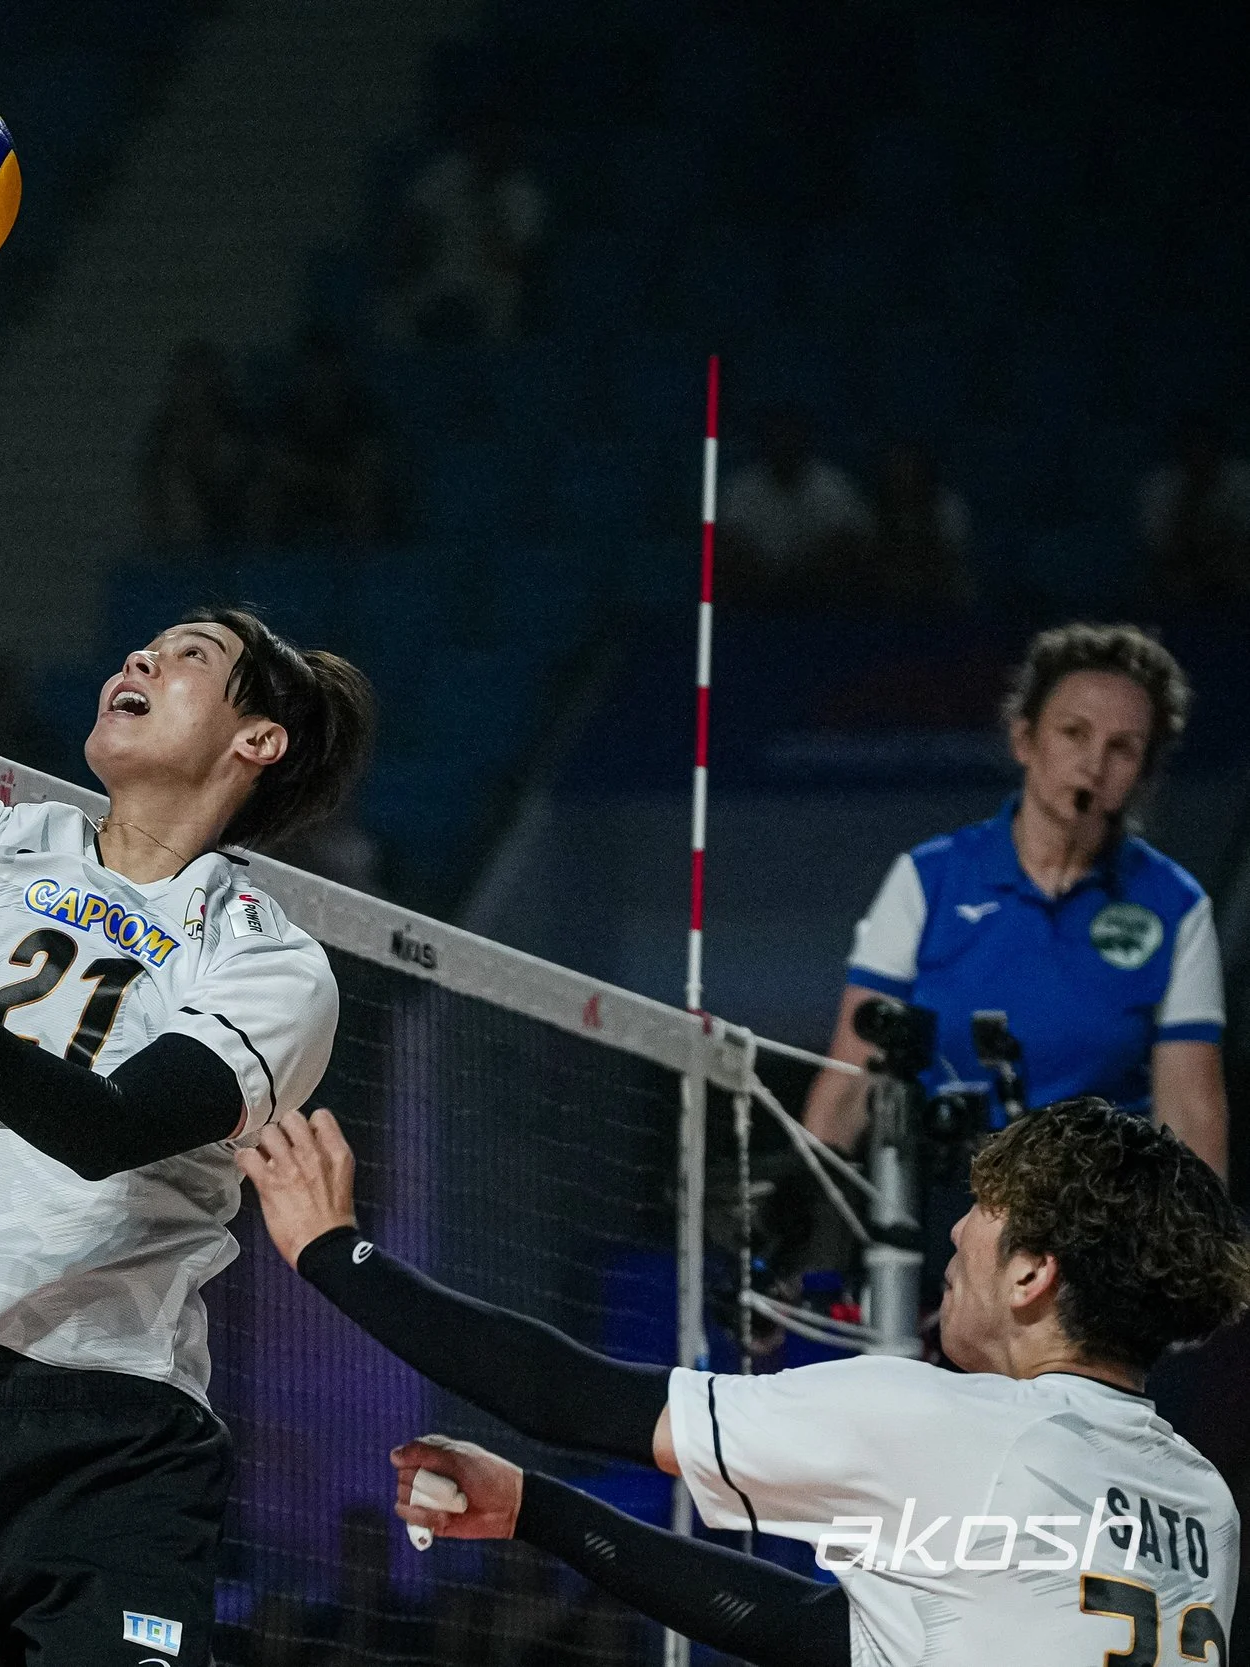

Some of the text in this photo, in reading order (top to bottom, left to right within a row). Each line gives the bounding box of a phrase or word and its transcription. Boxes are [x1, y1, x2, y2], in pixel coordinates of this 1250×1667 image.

[24, 878, 181, 968] CAPCOM
[242, 903, 263, 933] POWER
[1107, 1486, 1210, 1579] SATO
[126, 1614, 179, 1650] TEL
